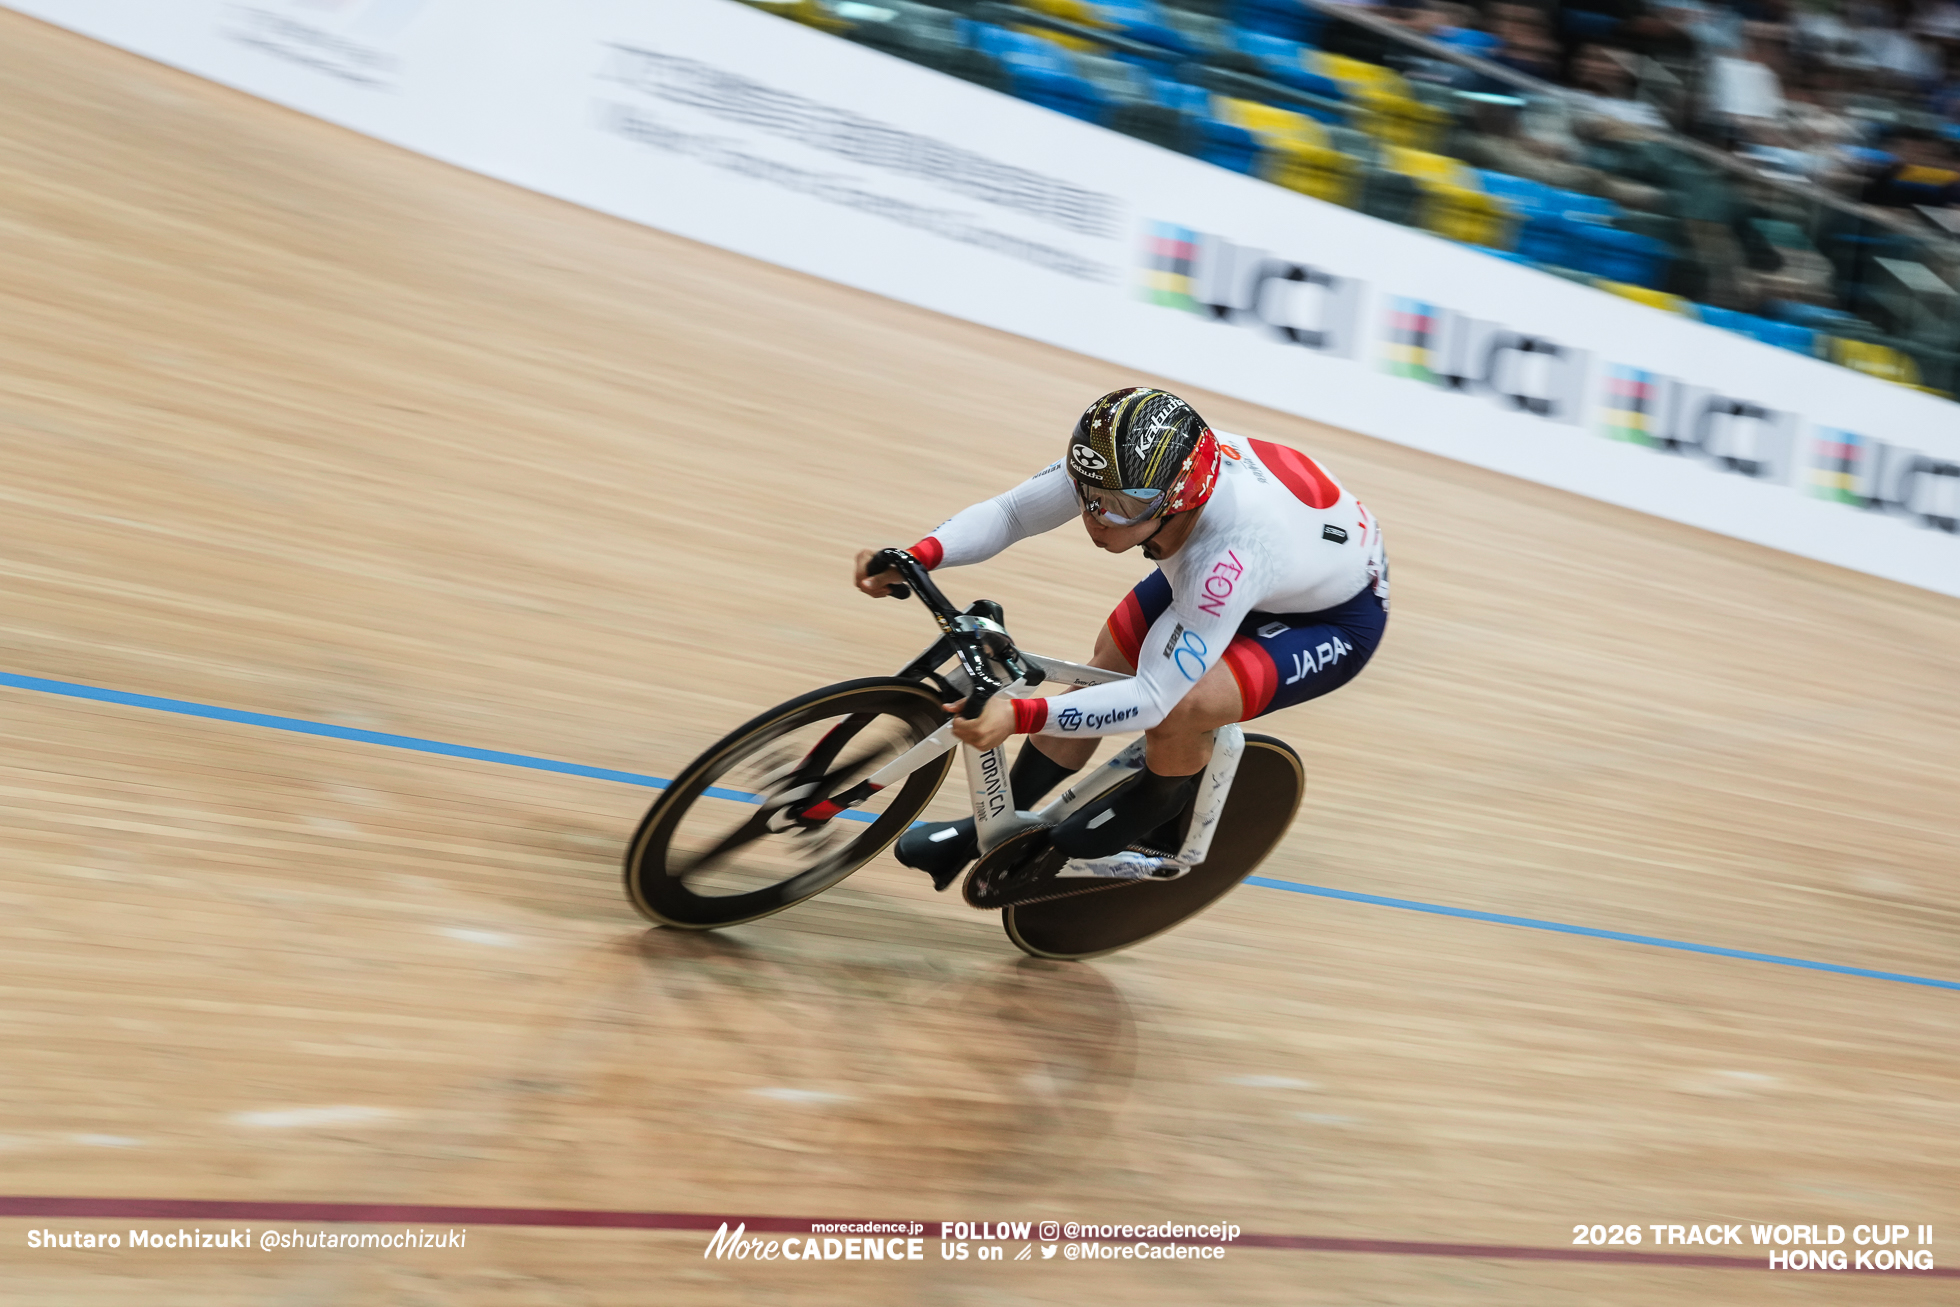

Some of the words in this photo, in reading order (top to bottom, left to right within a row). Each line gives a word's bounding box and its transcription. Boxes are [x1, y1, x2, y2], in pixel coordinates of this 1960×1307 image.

[1135, 398, 1186, 461] Kabuto
[1069, 459, 1104, 481] Kabuto
[1162, 622, 1184, 660] KEIRIN
[1285, 636, 1353, 685] JAPA
[1086, 706, 1139, 730] Cyclers
